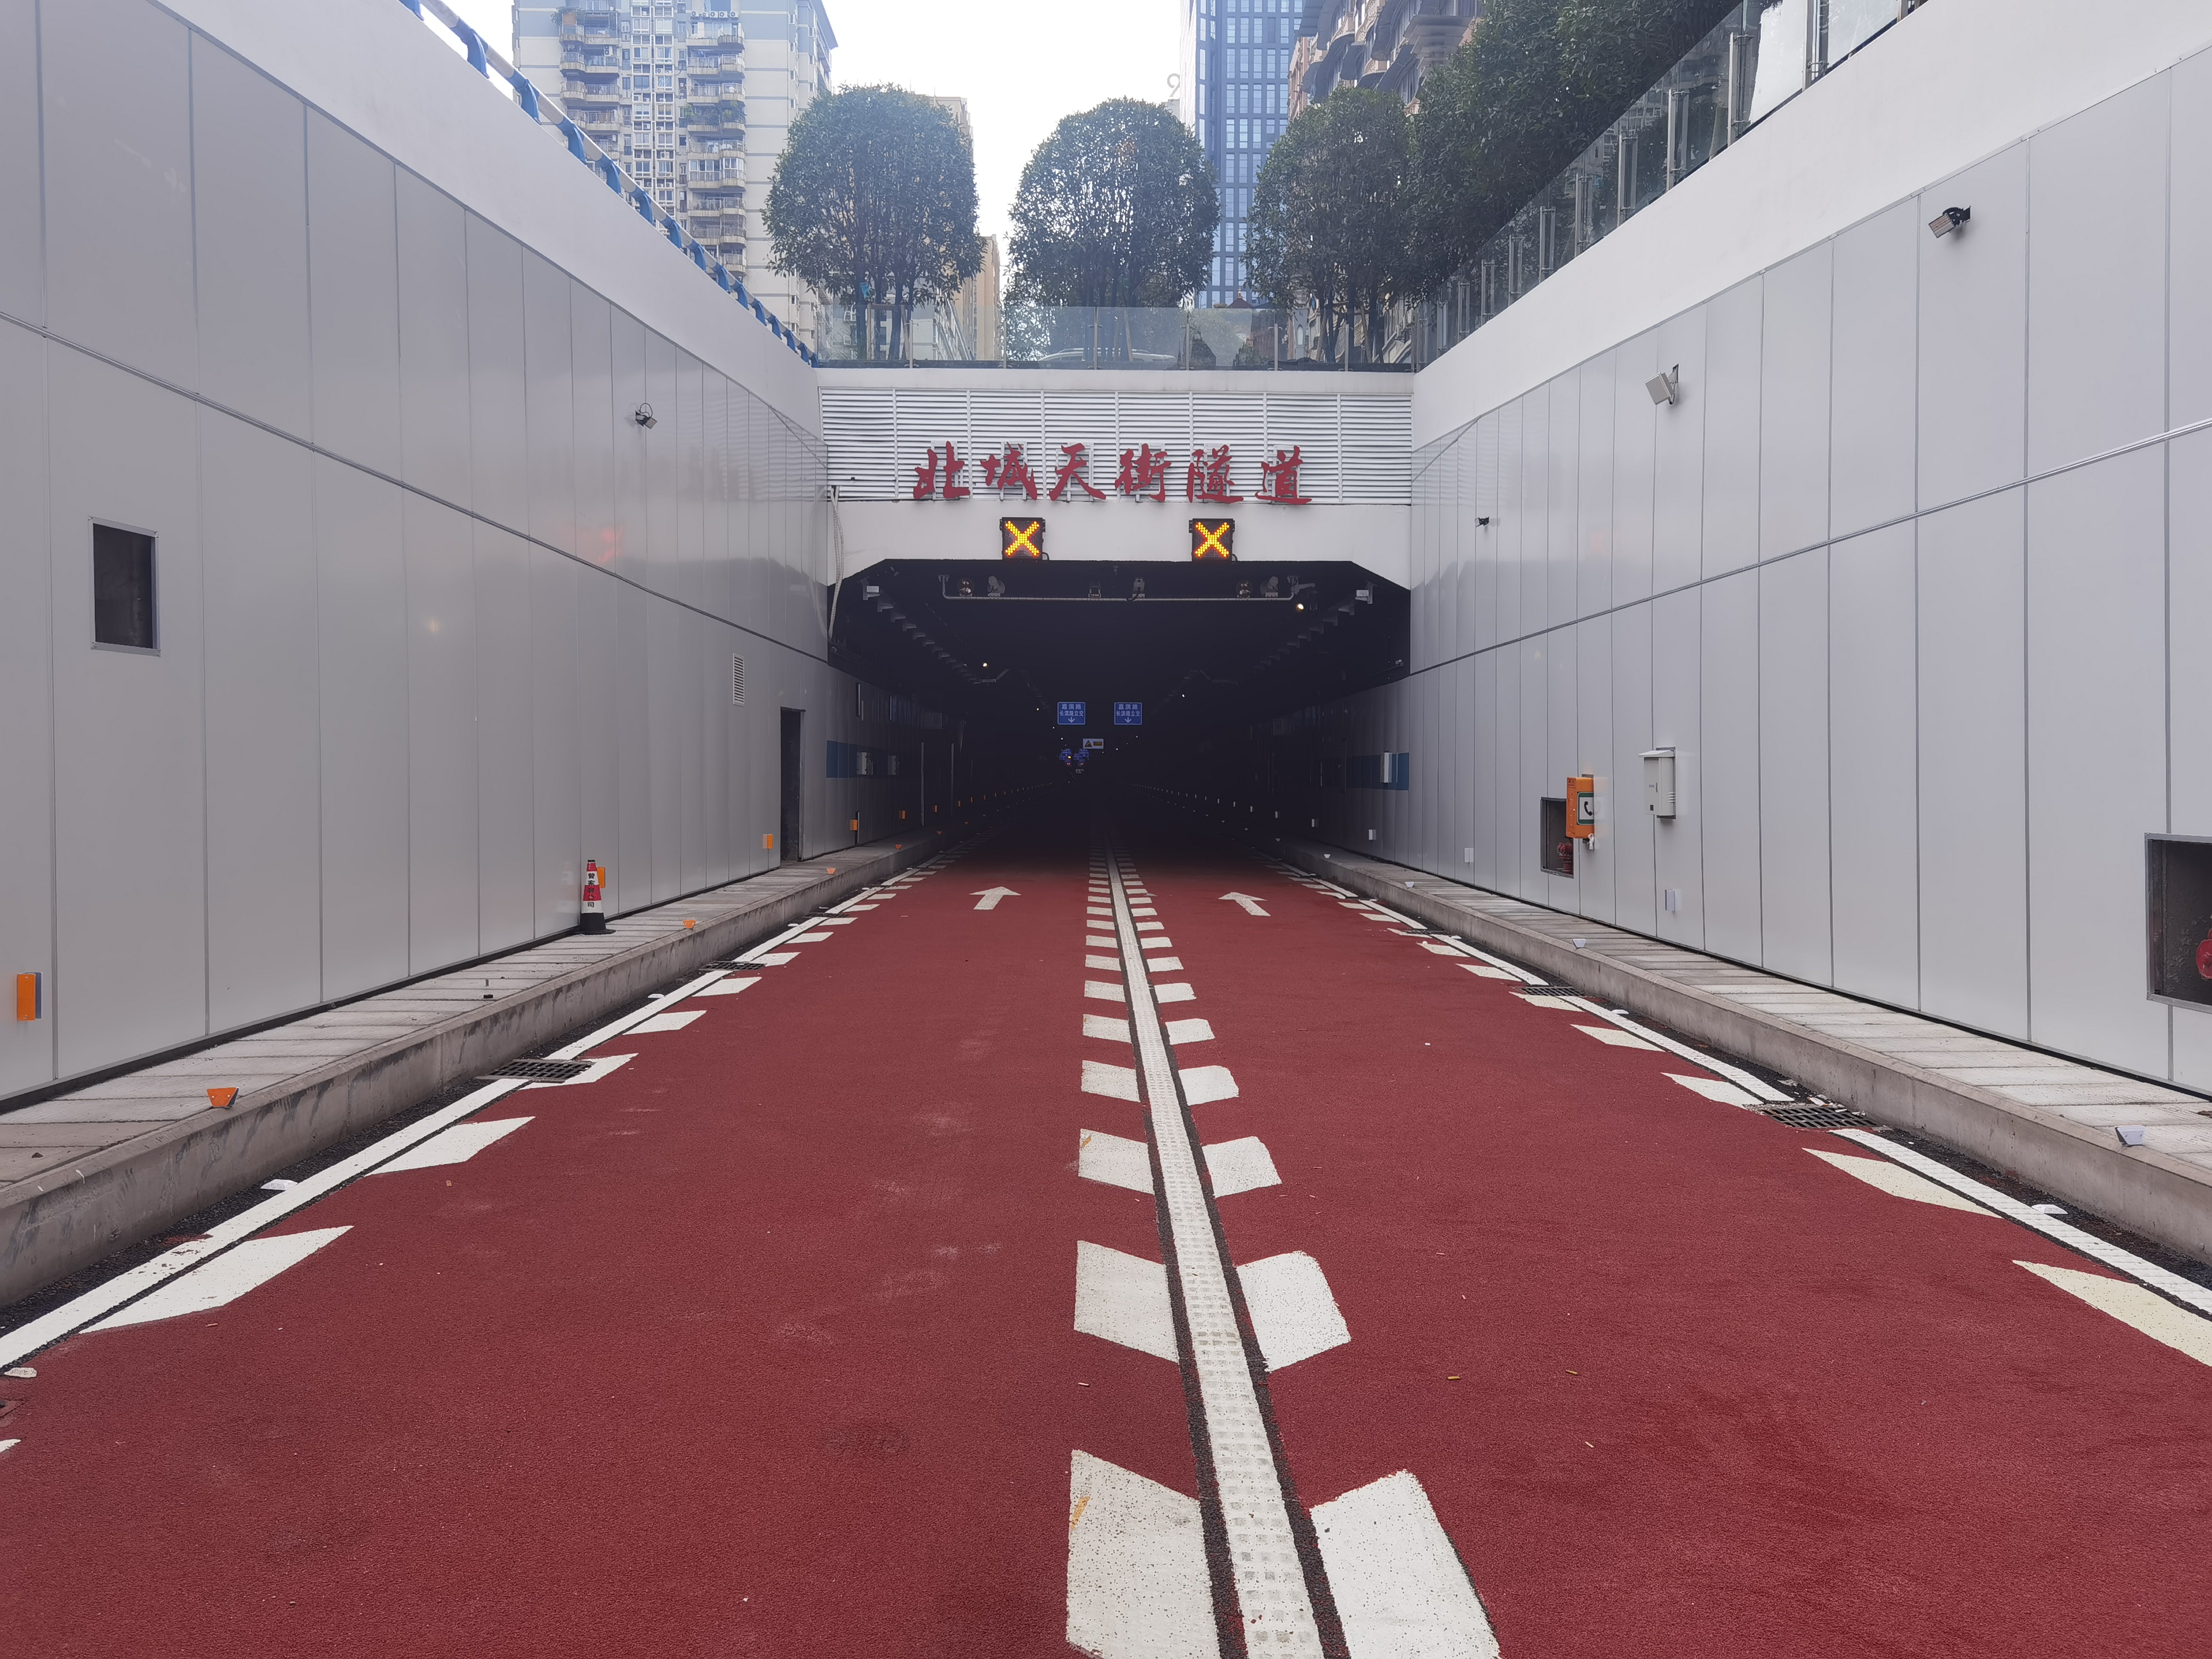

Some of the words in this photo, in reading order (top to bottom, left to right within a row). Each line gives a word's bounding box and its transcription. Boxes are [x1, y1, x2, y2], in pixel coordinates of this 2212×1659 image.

[913, 441, 1312, 504] 北城天街隧道
